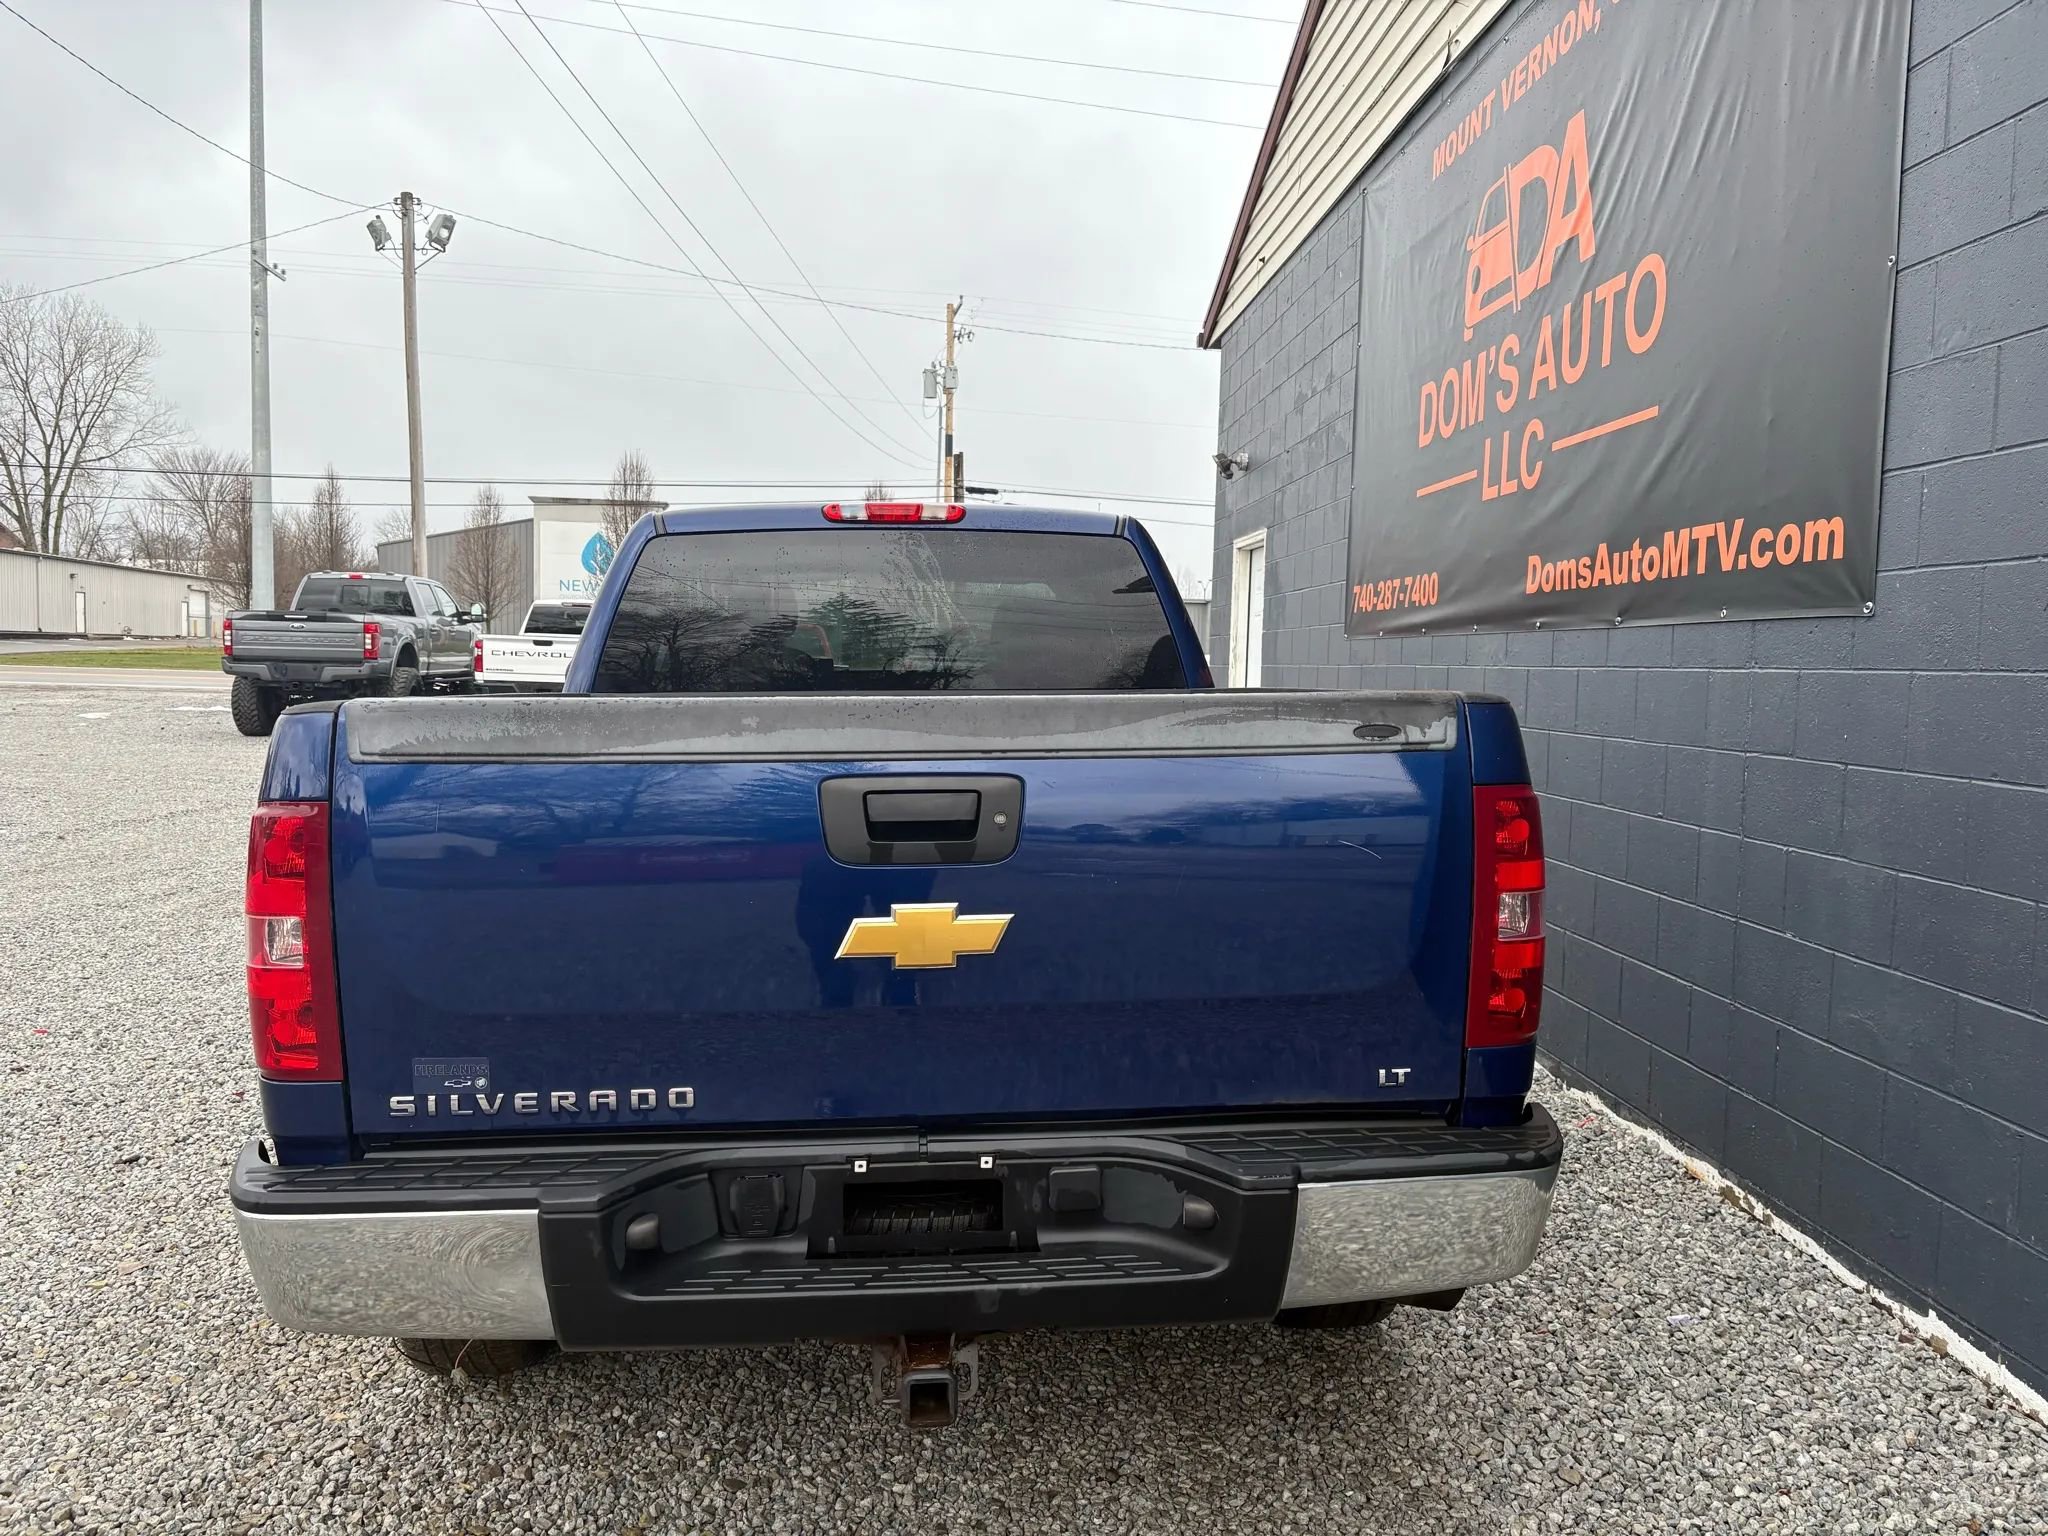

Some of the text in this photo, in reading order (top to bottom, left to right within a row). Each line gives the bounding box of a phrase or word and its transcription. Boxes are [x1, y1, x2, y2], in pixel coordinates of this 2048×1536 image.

[1432, 0, 1601, 181] MOUNT VERNON,
[1418, 253, 1668, 449] DOM'S AUTO
[1481, 418, 1545, 502] LLC
[1525, 515, 1845, 595] DomsAutoMTV.com
[559, 579, 598, 592] NEW
[1353, 572, 1439, 613] 740-287-7400
[491, 649, 572, 659] CHEVROL
[414, 1063, 487, 1077] FIRELANDS
[1378, 1068, 1411, 1087] LT
[389, 1087, 695, 1117] SILVERADO
